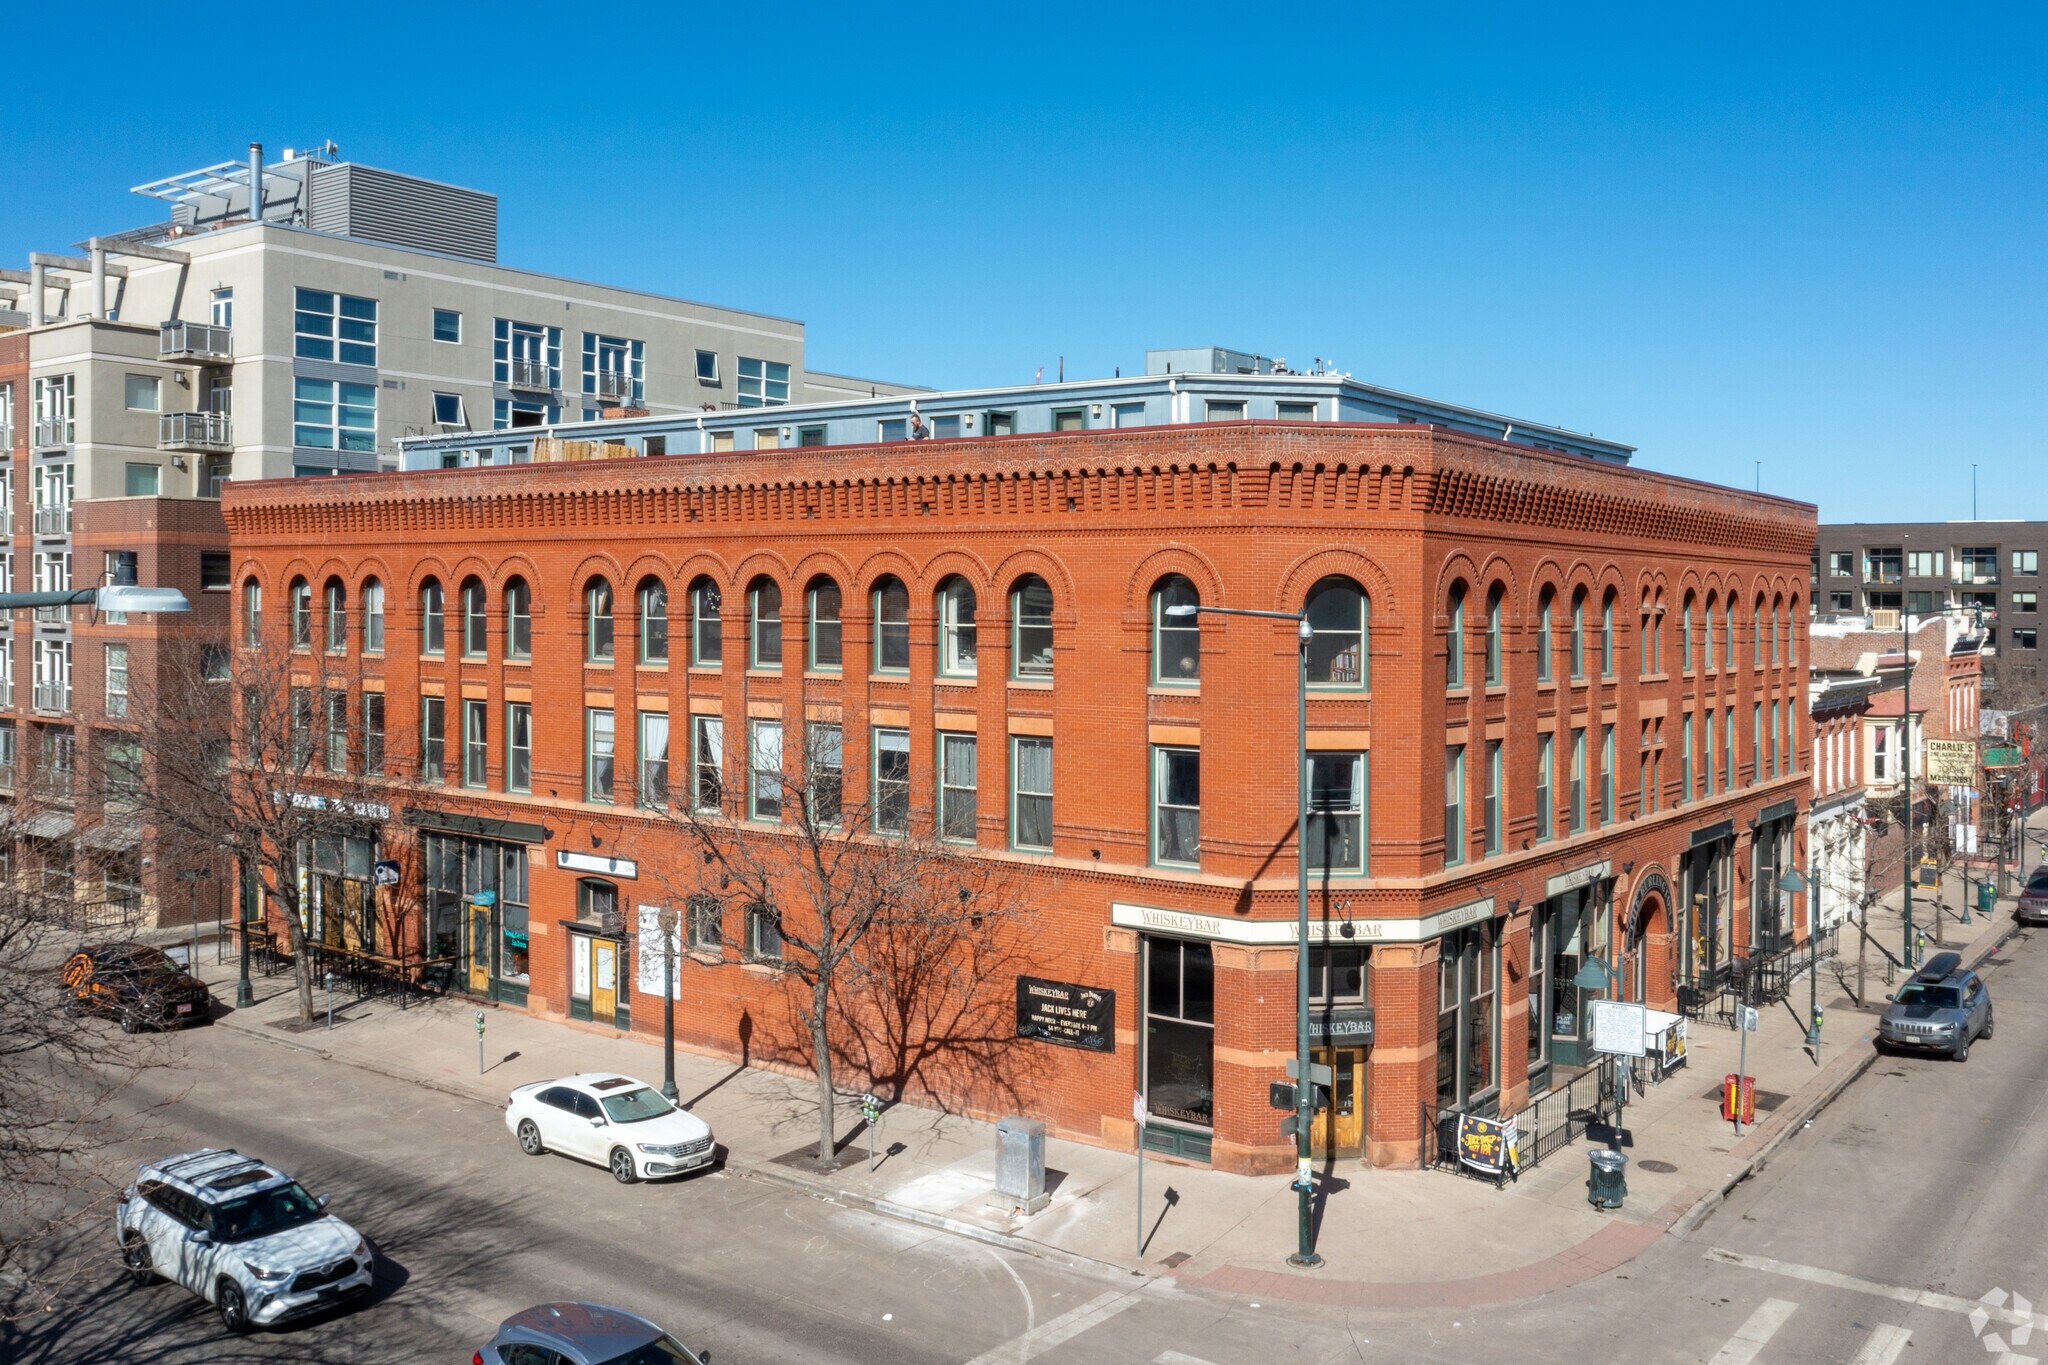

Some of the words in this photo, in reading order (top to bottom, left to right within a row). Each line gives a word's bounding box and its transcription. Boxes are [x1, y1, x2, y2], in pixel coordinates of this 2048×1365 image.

[1930, 742, 1974, 753] CHARLIE'S
[1142, 910, 1221, 935] WHISKEYBAR
[1437, 906, 1478, 931] WHISKEYBAR
[1028, 984, 1069, 1000] WHISKEYBAR
[1031, 1014, 1045, 1023] HAPPY
[1041, 1003, 1055, 1014] JACK
[1055, 1005, 1072, 1016] LIVES
[1072, 1008, 1087, 1019] HERE
[1155, 1103, 1209, 1124] WHISKEYBAR
[1480, 1145, 1493, 1156] IPA
